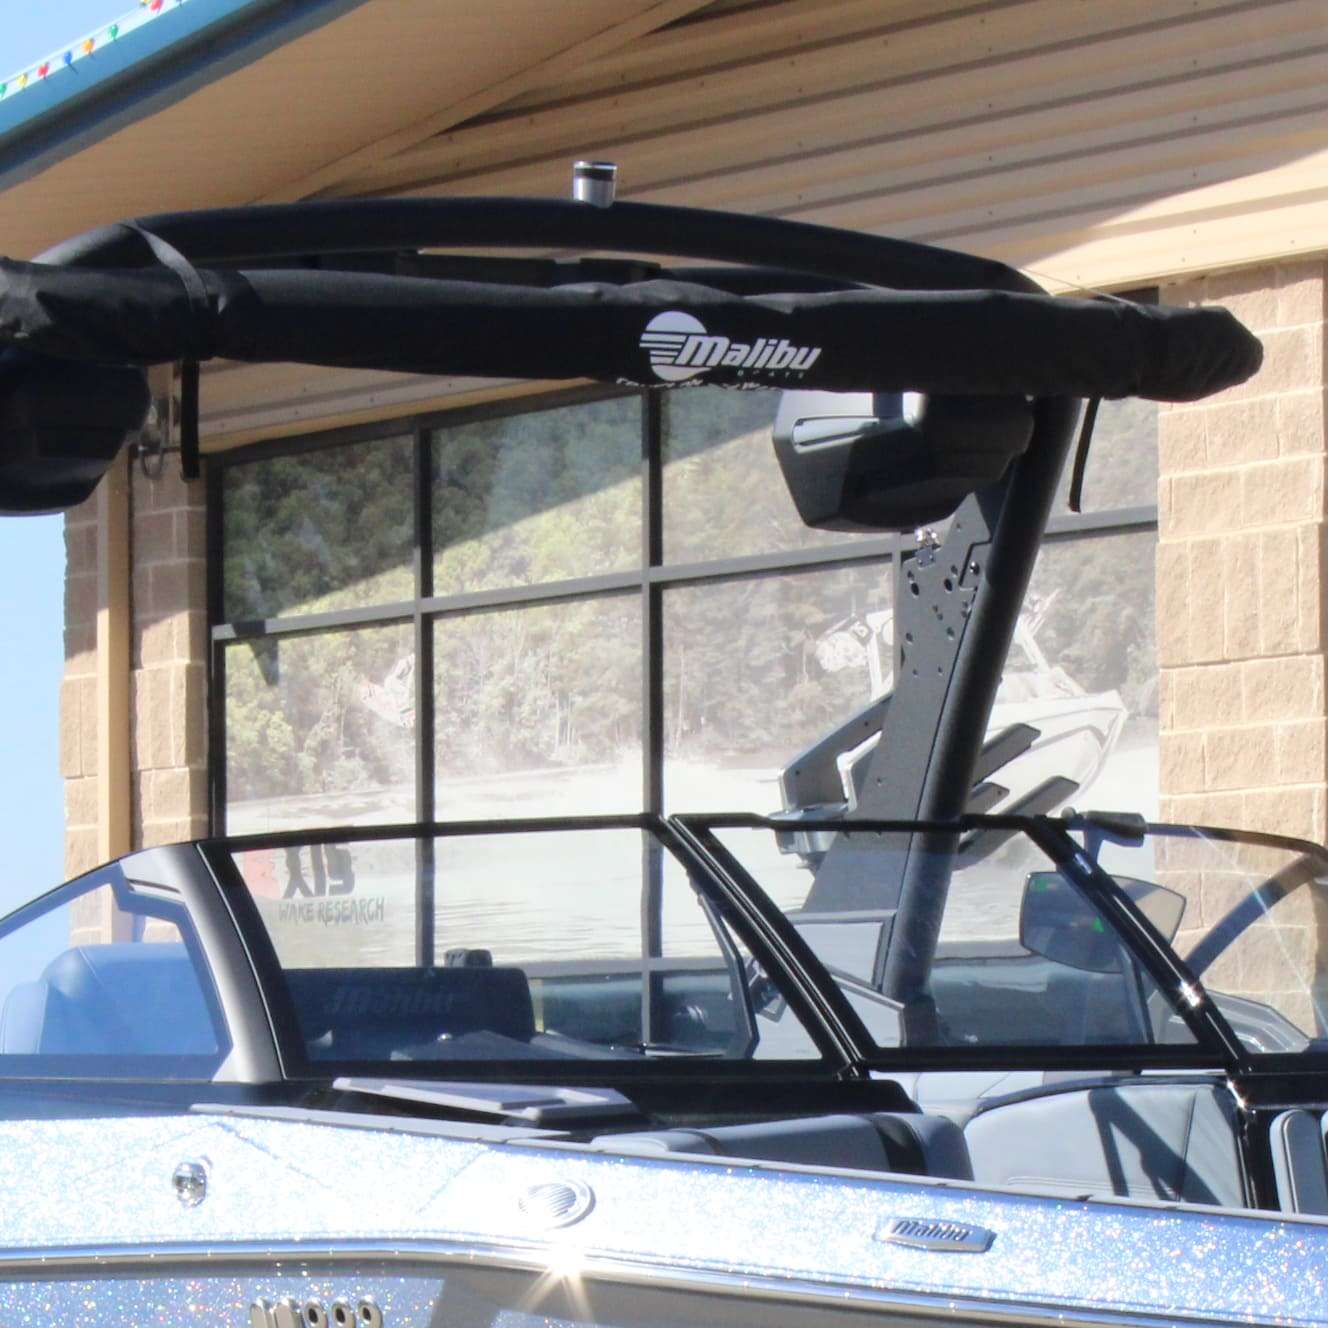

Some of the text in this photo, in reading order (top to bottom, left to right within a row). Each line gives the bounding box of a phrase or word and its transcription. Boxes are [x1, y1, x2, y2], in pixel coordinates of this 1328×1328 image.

[674, 334, 822, 370] Malibu
[278, 897, 385, 927] WAKE RESEARCH
[891, 1220, 971, 1242] Malibu
